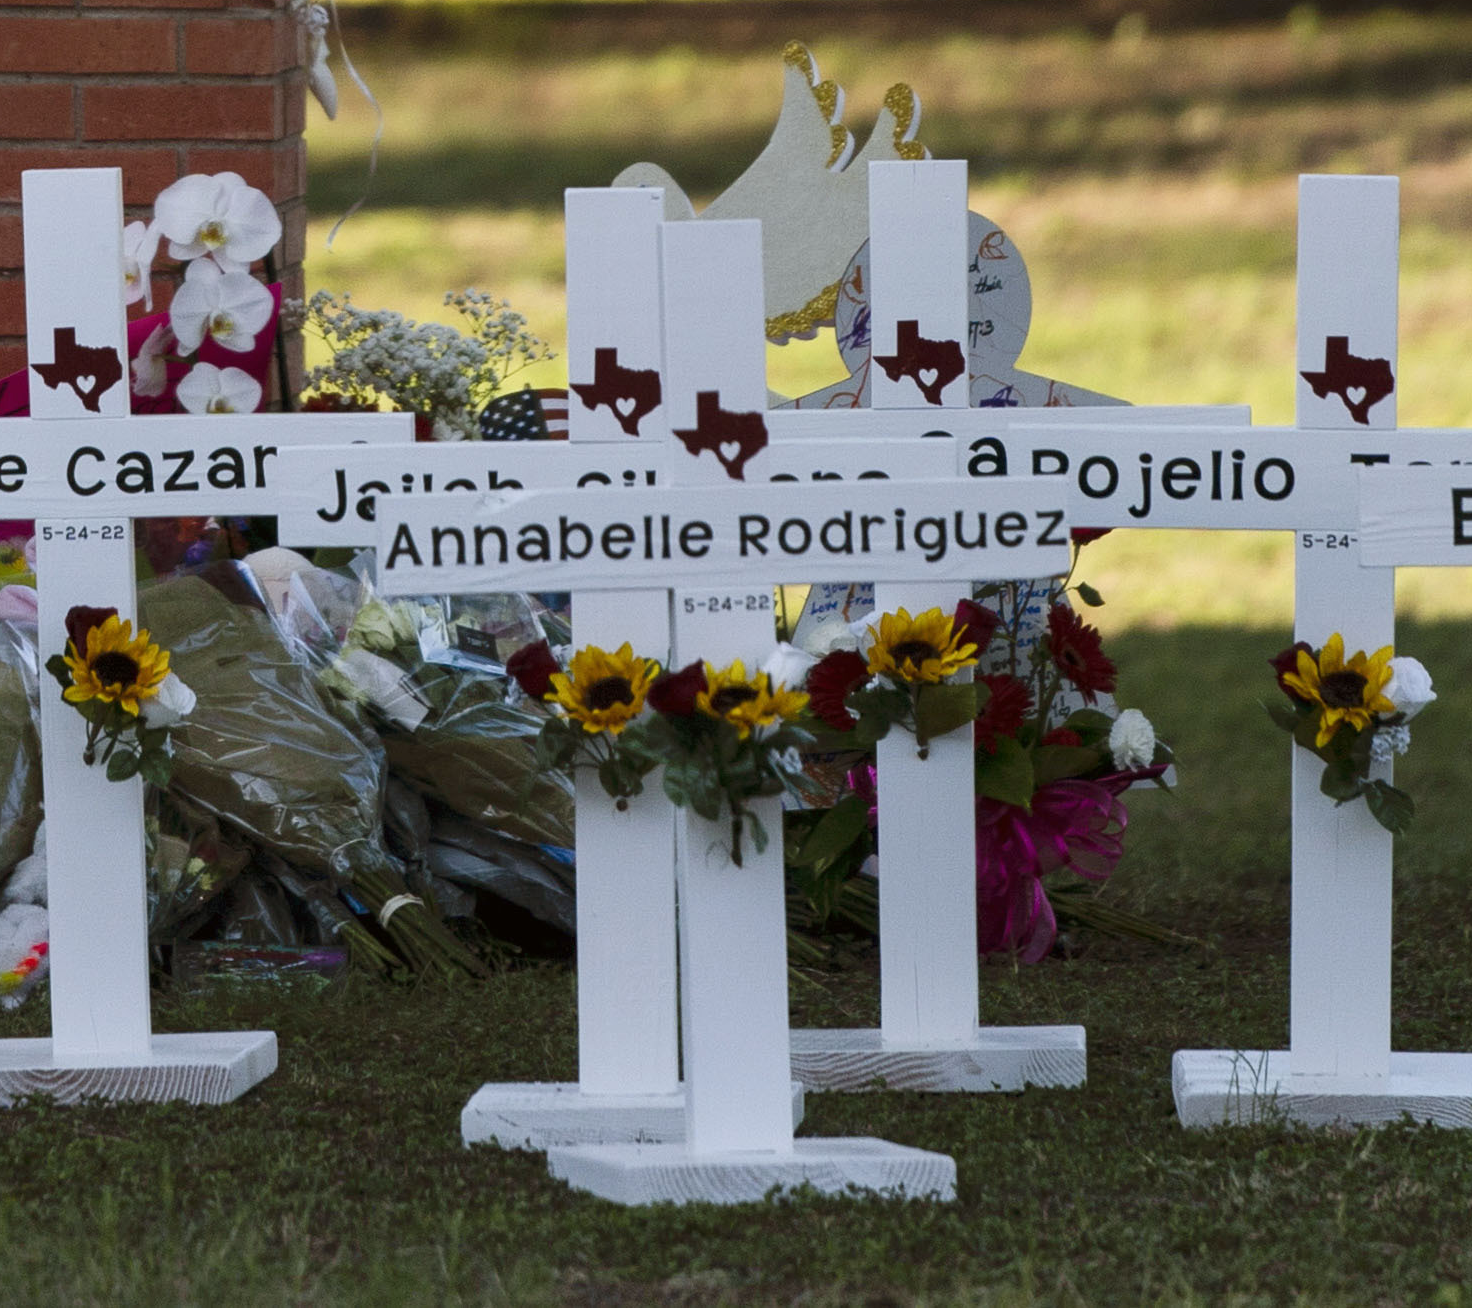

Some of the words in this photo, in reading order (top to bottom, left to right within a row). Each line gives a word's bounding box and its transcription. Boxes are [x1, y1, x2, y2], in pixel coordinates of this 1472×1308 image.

[42, 524, 125, 542] 5-24-22
[385, 513, 713, 570] Annabelle
[738, 508, 1068, 563] Rodriguez
[684, 595, 771, 613] 5-24-22
